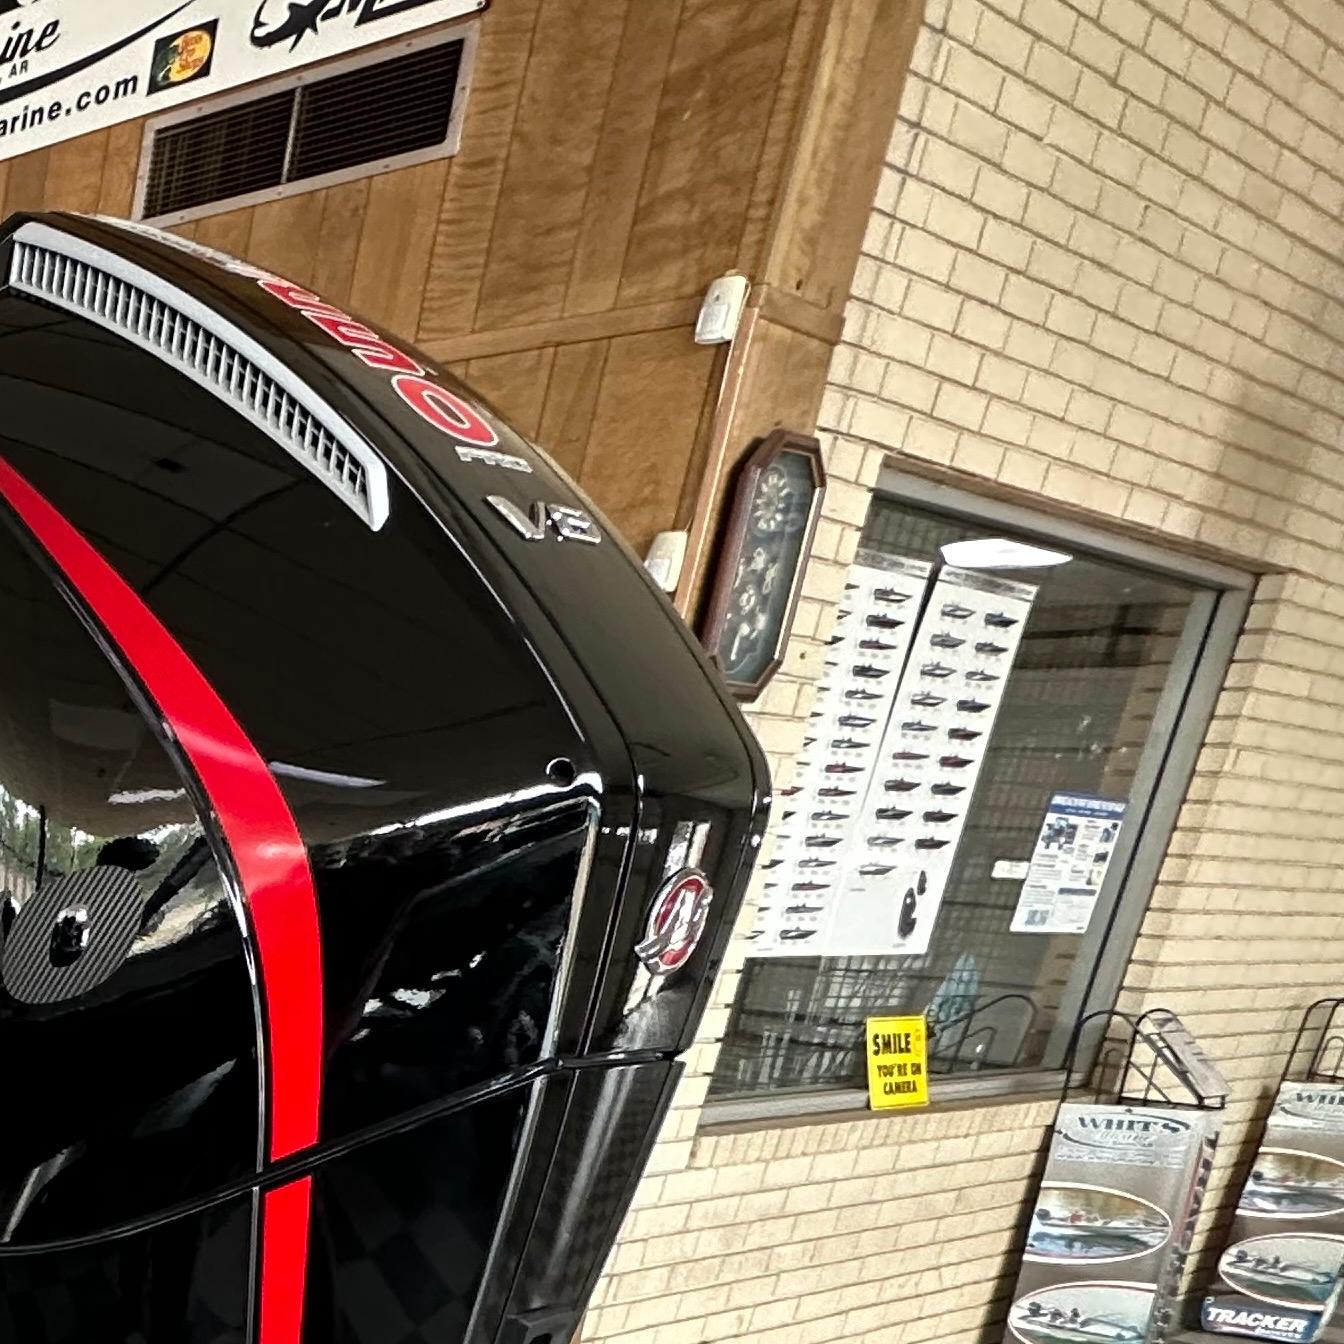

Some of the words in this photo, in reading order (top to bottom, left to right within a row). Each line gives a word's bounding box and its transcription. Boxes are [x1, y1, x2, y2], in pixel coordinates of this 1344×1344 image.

[8, 59, 29, 79] AR
[486, 495, 602, 544] V8
[873, 1033, 912, 1056] SMILE
[877, 1063, 908, 1077] YOU'RE
[911, 1063, 922, 1075] ON
[883, 1080, 918, 1095] CAMERA
[1207, 1308, 1309, 1333] TRACKER
